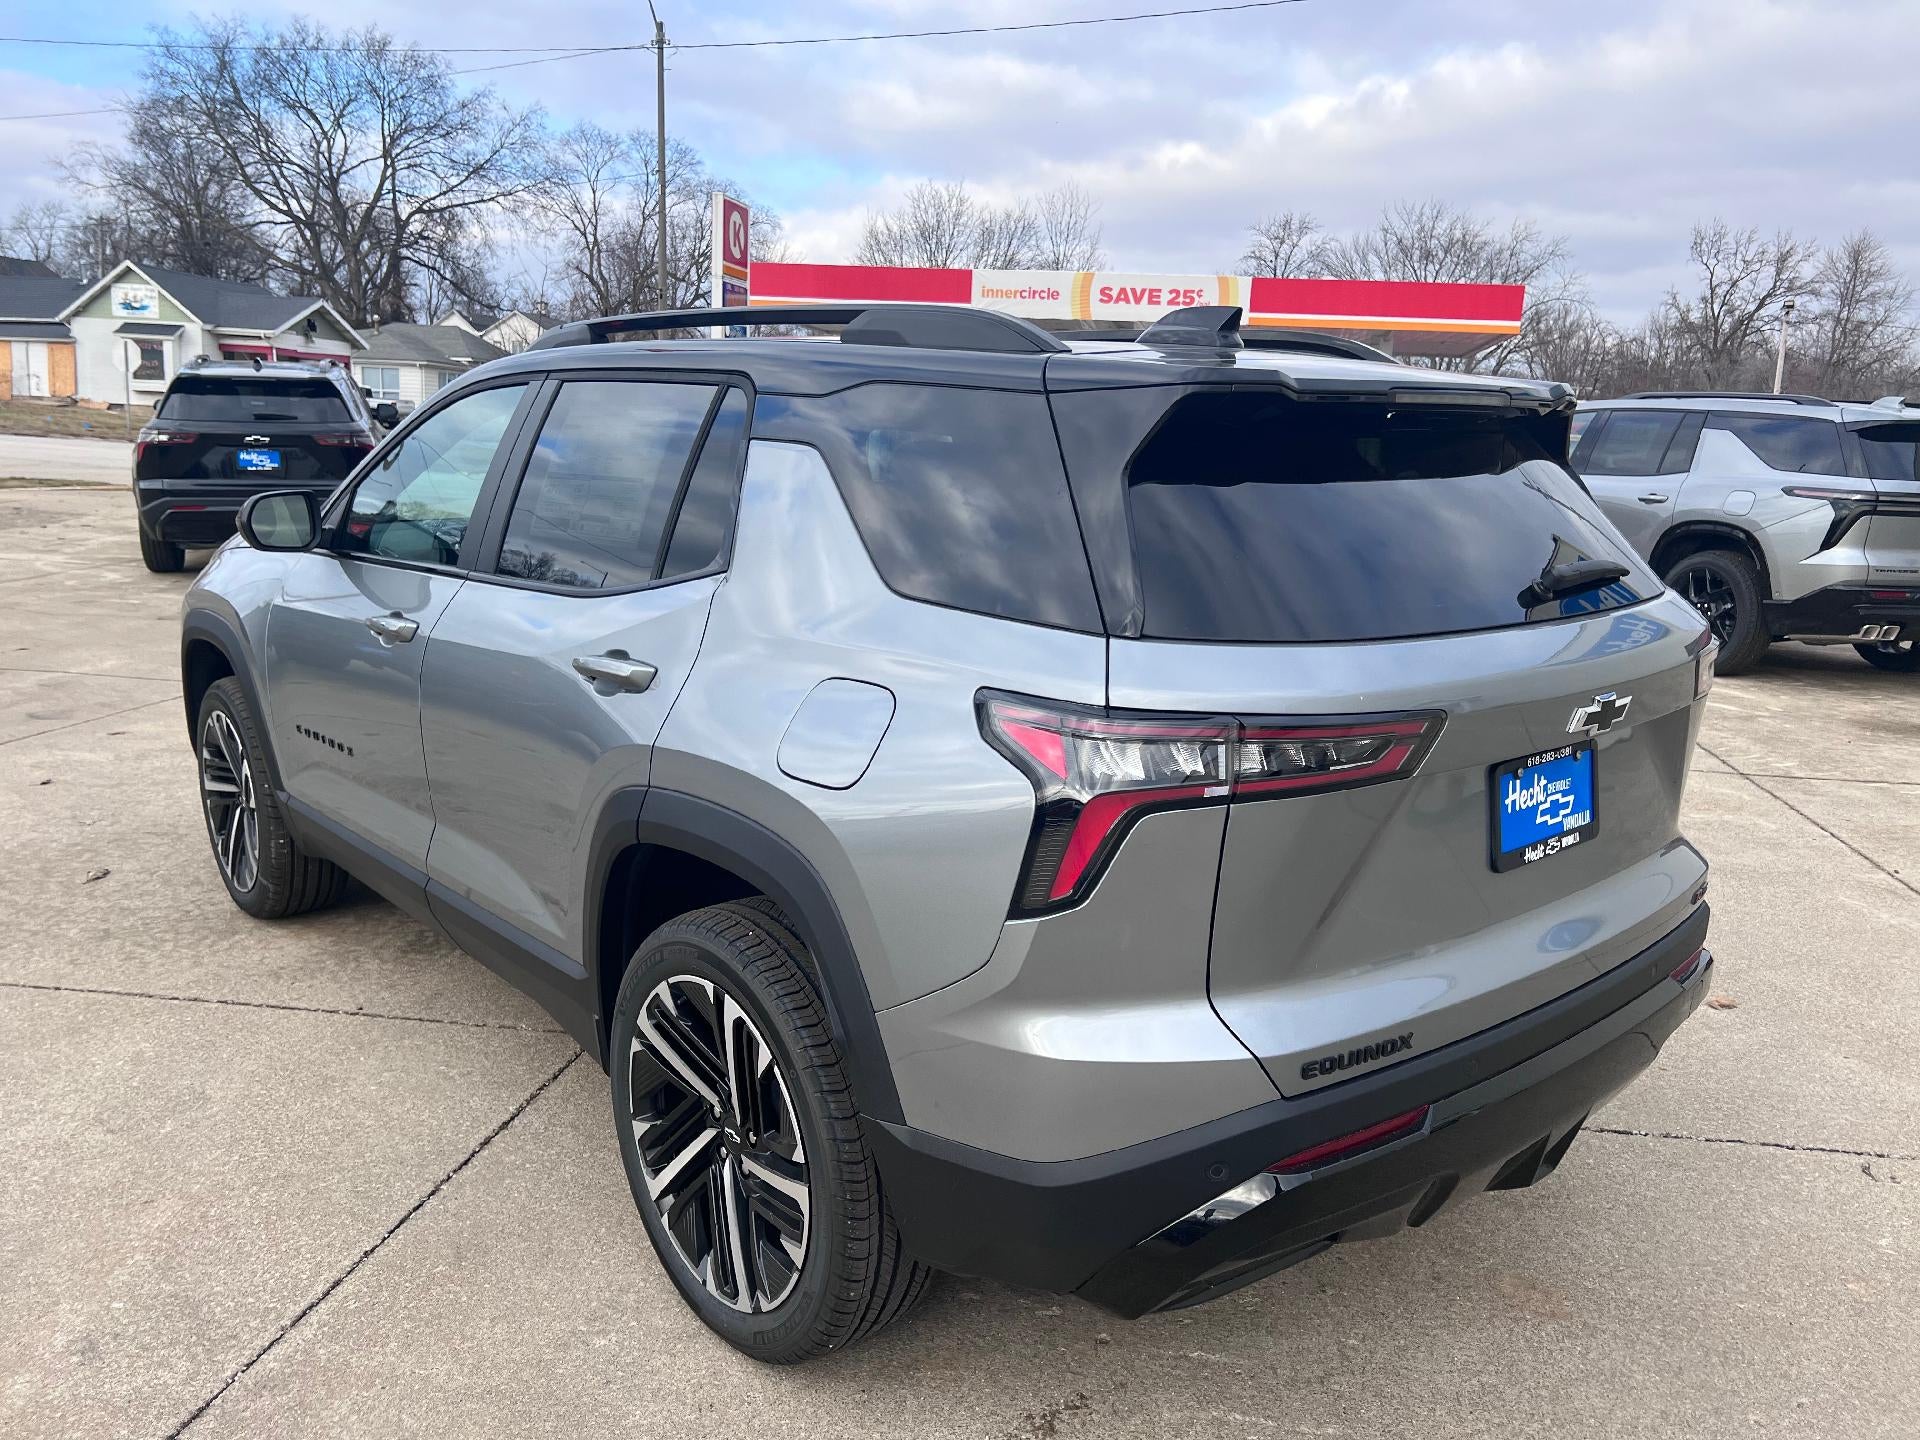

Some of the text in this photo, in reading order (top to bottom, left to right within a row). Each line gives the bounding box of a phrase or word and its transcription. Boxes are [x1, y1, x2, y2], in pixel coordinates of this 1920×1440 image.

[981, 286, 1061, 301] innercircle
[1099, 286, 1161, 306] SAVE
[1504, 773, 1547, 814] Hecht
[1524, 844, 1545, 863] Hecht
[1300, 1031, 1415, 1080] EQUINOX
